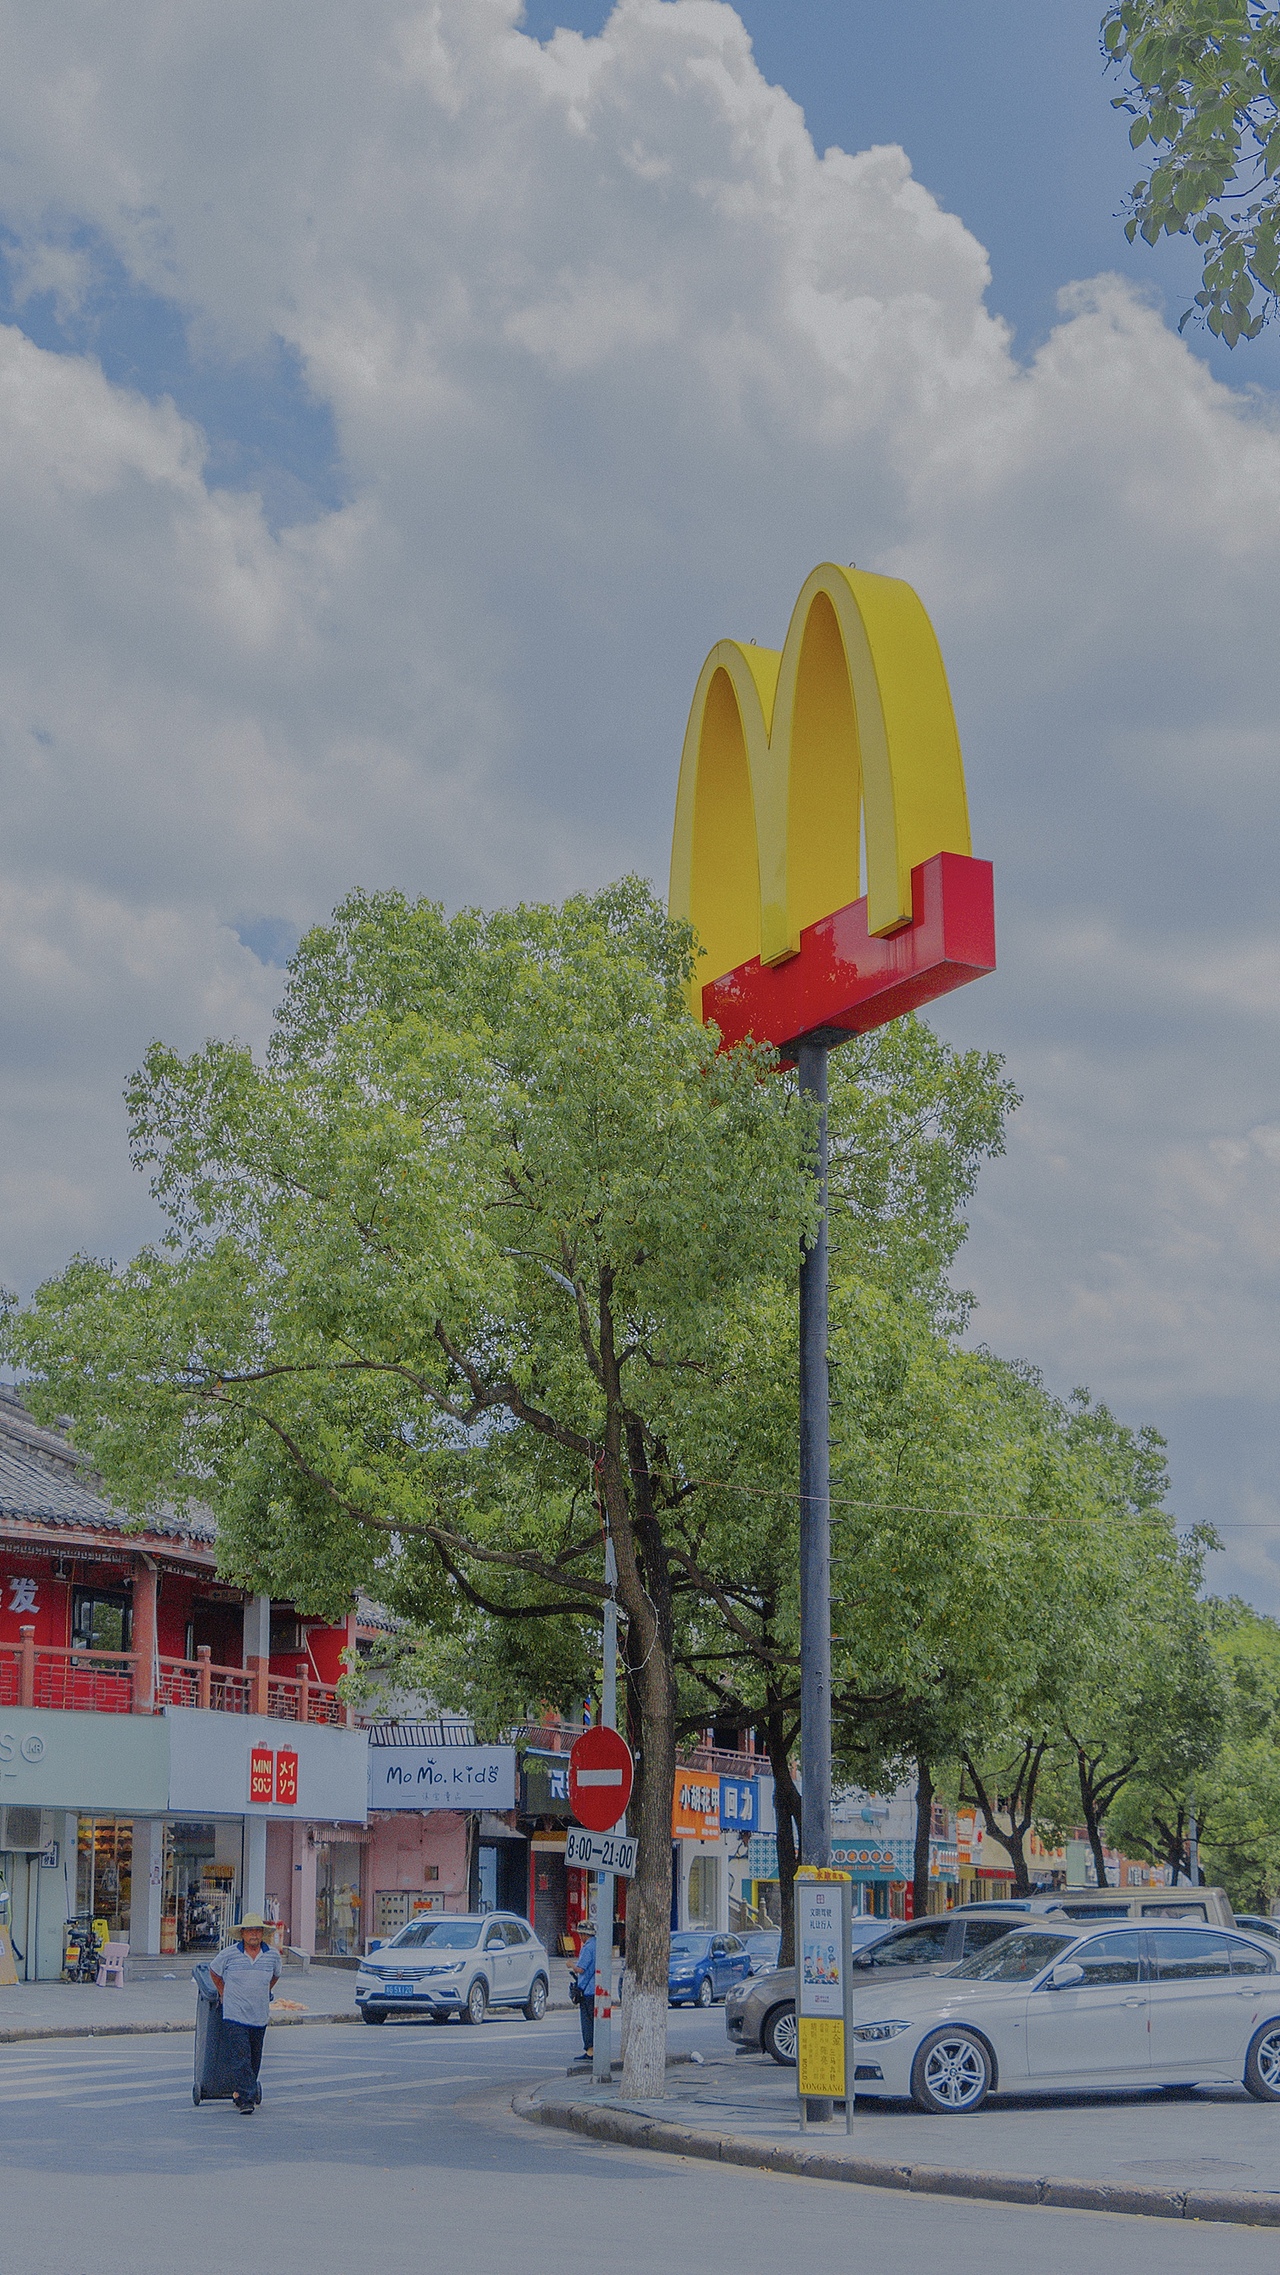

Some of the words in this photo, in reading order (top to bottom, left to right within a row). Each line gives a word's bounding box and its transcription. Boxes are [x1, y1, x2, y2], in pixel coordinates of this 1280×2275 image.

[0, 1578, 40, 1613] 发
[253, 1759, 272, 1775] MINI
[725, 1786, 753, 1821] 回力
[810, 1920, 832, 1930] 礼让行人
[801, 2081, 844, 2093] YONGKANG
